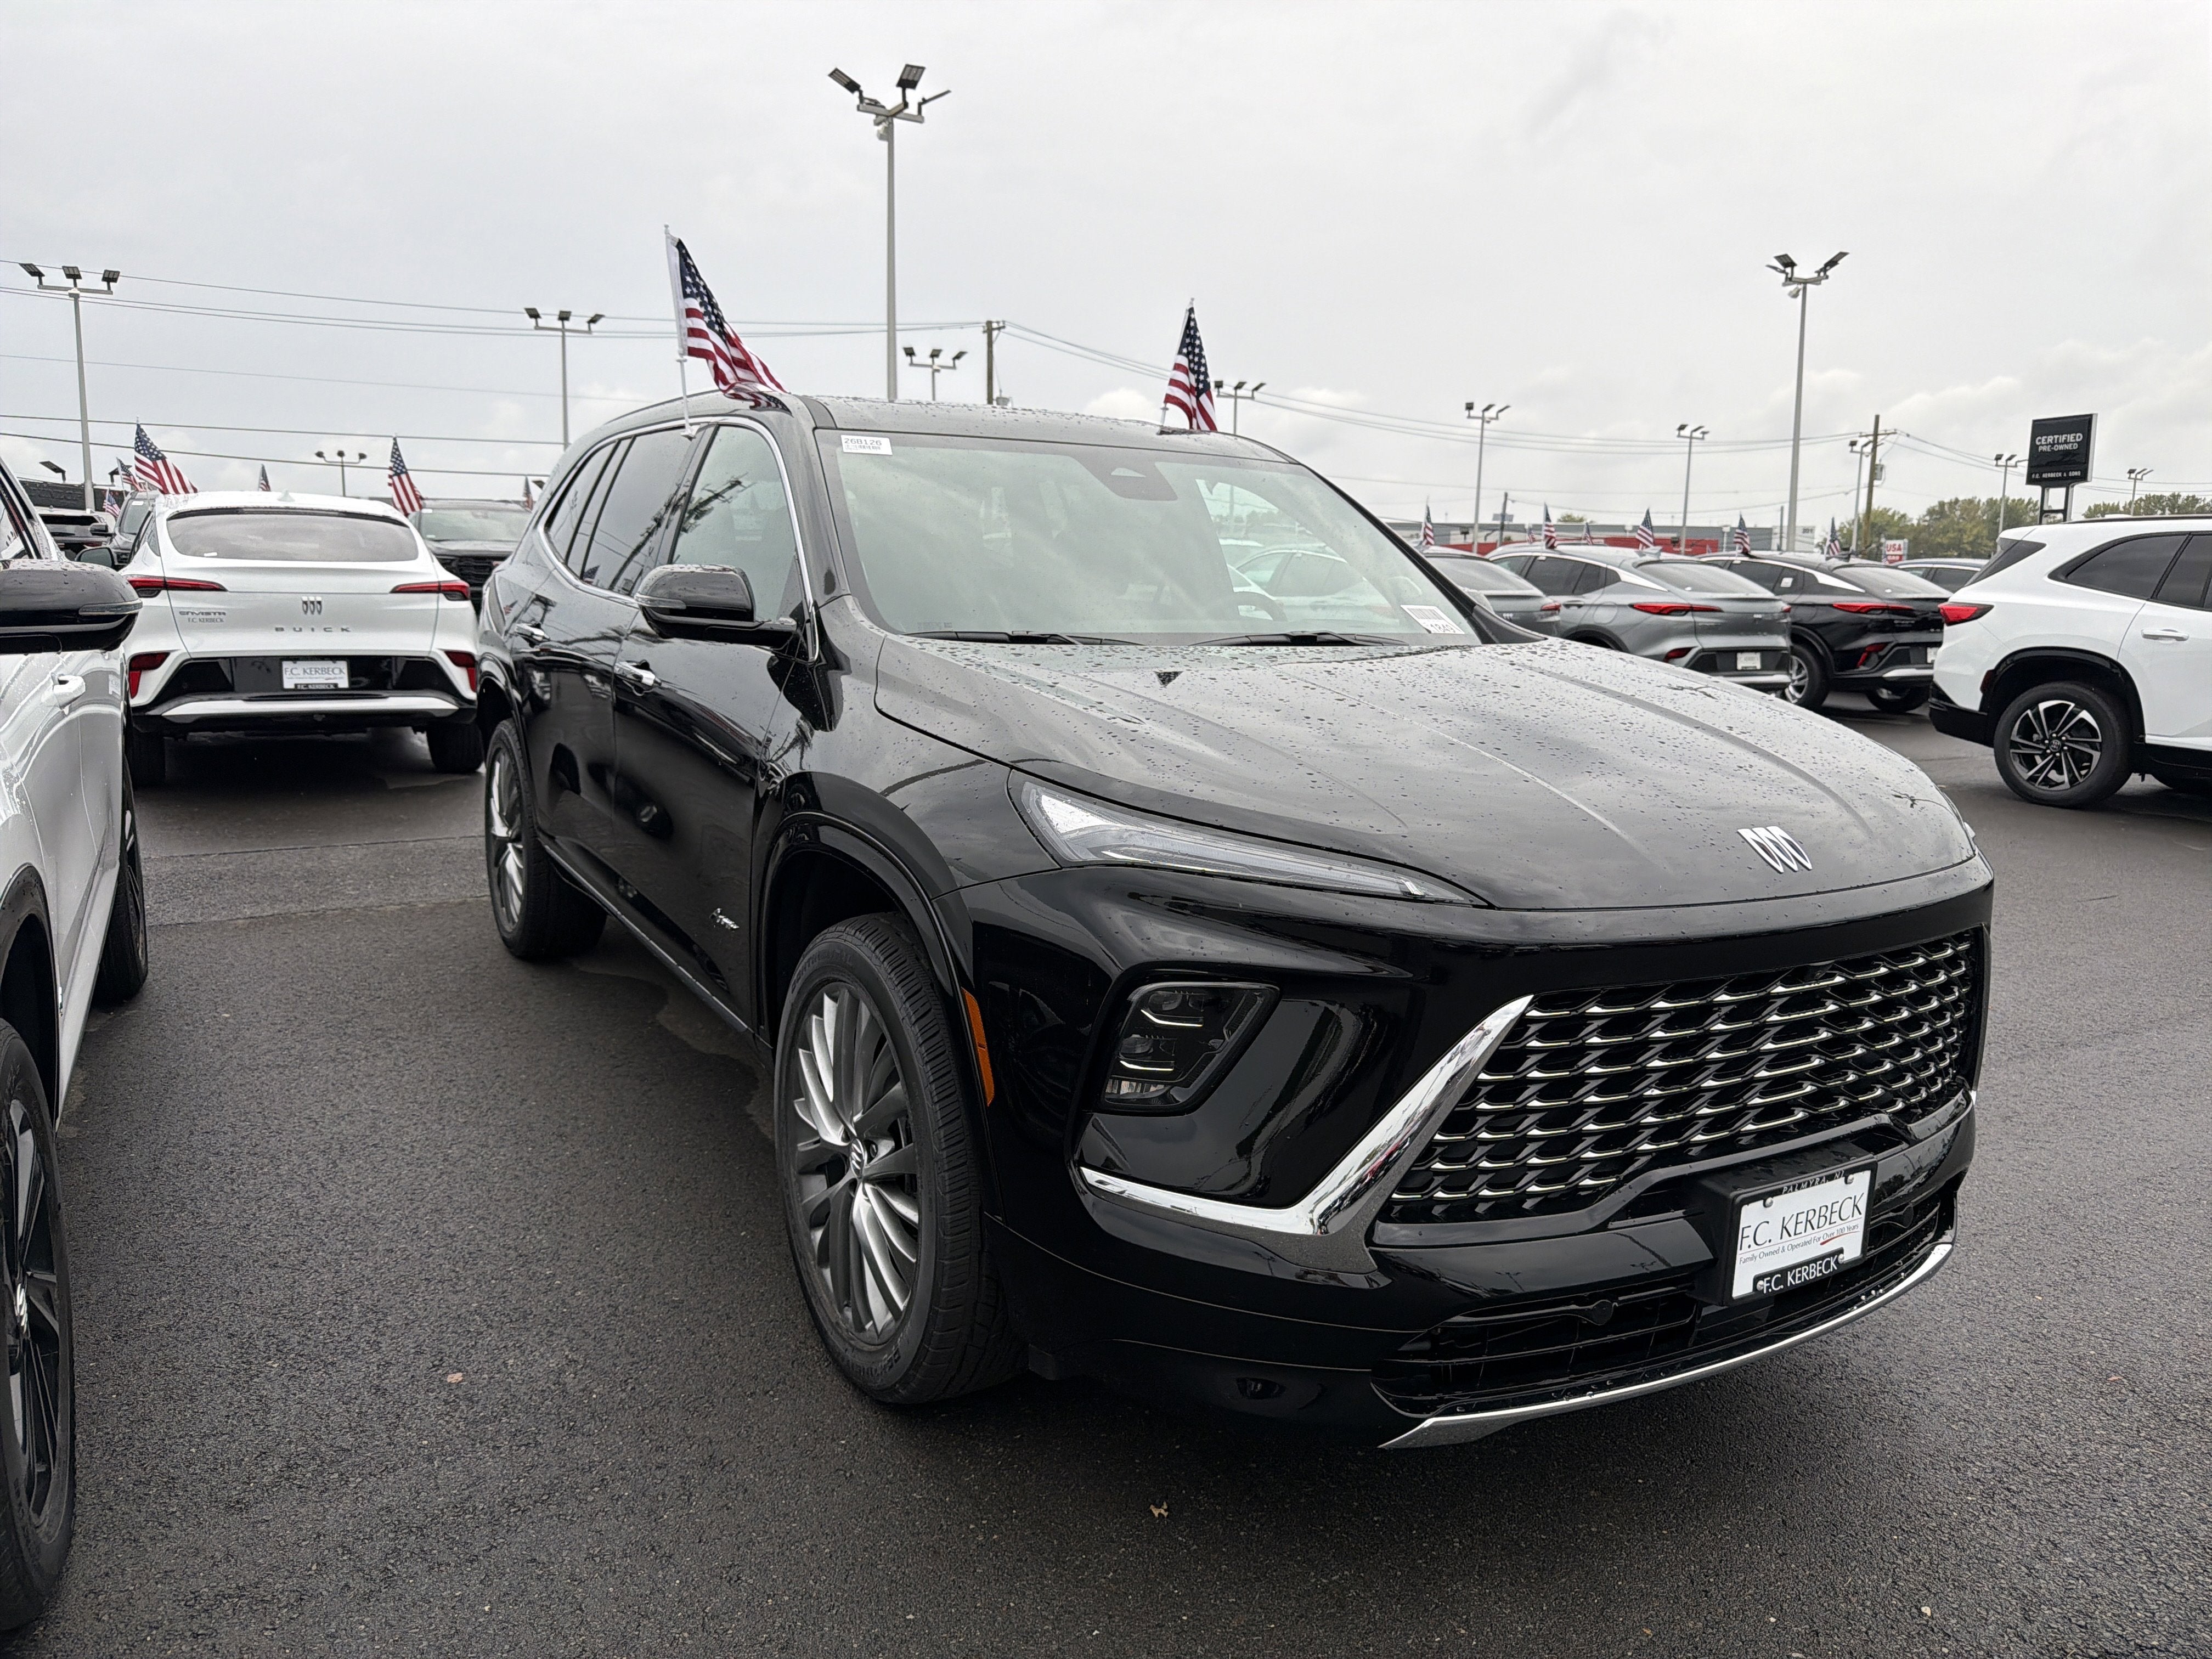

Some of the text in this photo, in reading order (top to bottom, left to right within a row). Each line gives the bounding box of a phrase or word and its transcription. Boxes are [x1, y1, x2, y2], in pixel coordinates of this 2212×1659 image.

[2035, 433, 2083, 445] CERTIFIED
[2039, 443, 2078, 453] PRE-OWNED
[1886, 543, 1902, 552] USA
[284, 667, 345, 676] F.C. KERBECK
[1782, 1176, 1829, 1195] PALMYRA,
[1740, 1193, 1864, 1250] F.C. KERBECK
[1739, 1254, 1757, 1265] Family
[1758, 1246, 1780, 1259] Owned
[1787, 1237, 1812, 1252] Operated
[1813, 1235, 1821, 1244] For
[1822, 1232, 1835, 1240] Over
[1836, 1226, 1845, 1234] 100
[1846, 1224, 1859, 1232] Years
[1763, 1255, 1837, 1294] F.C. KERBECK
